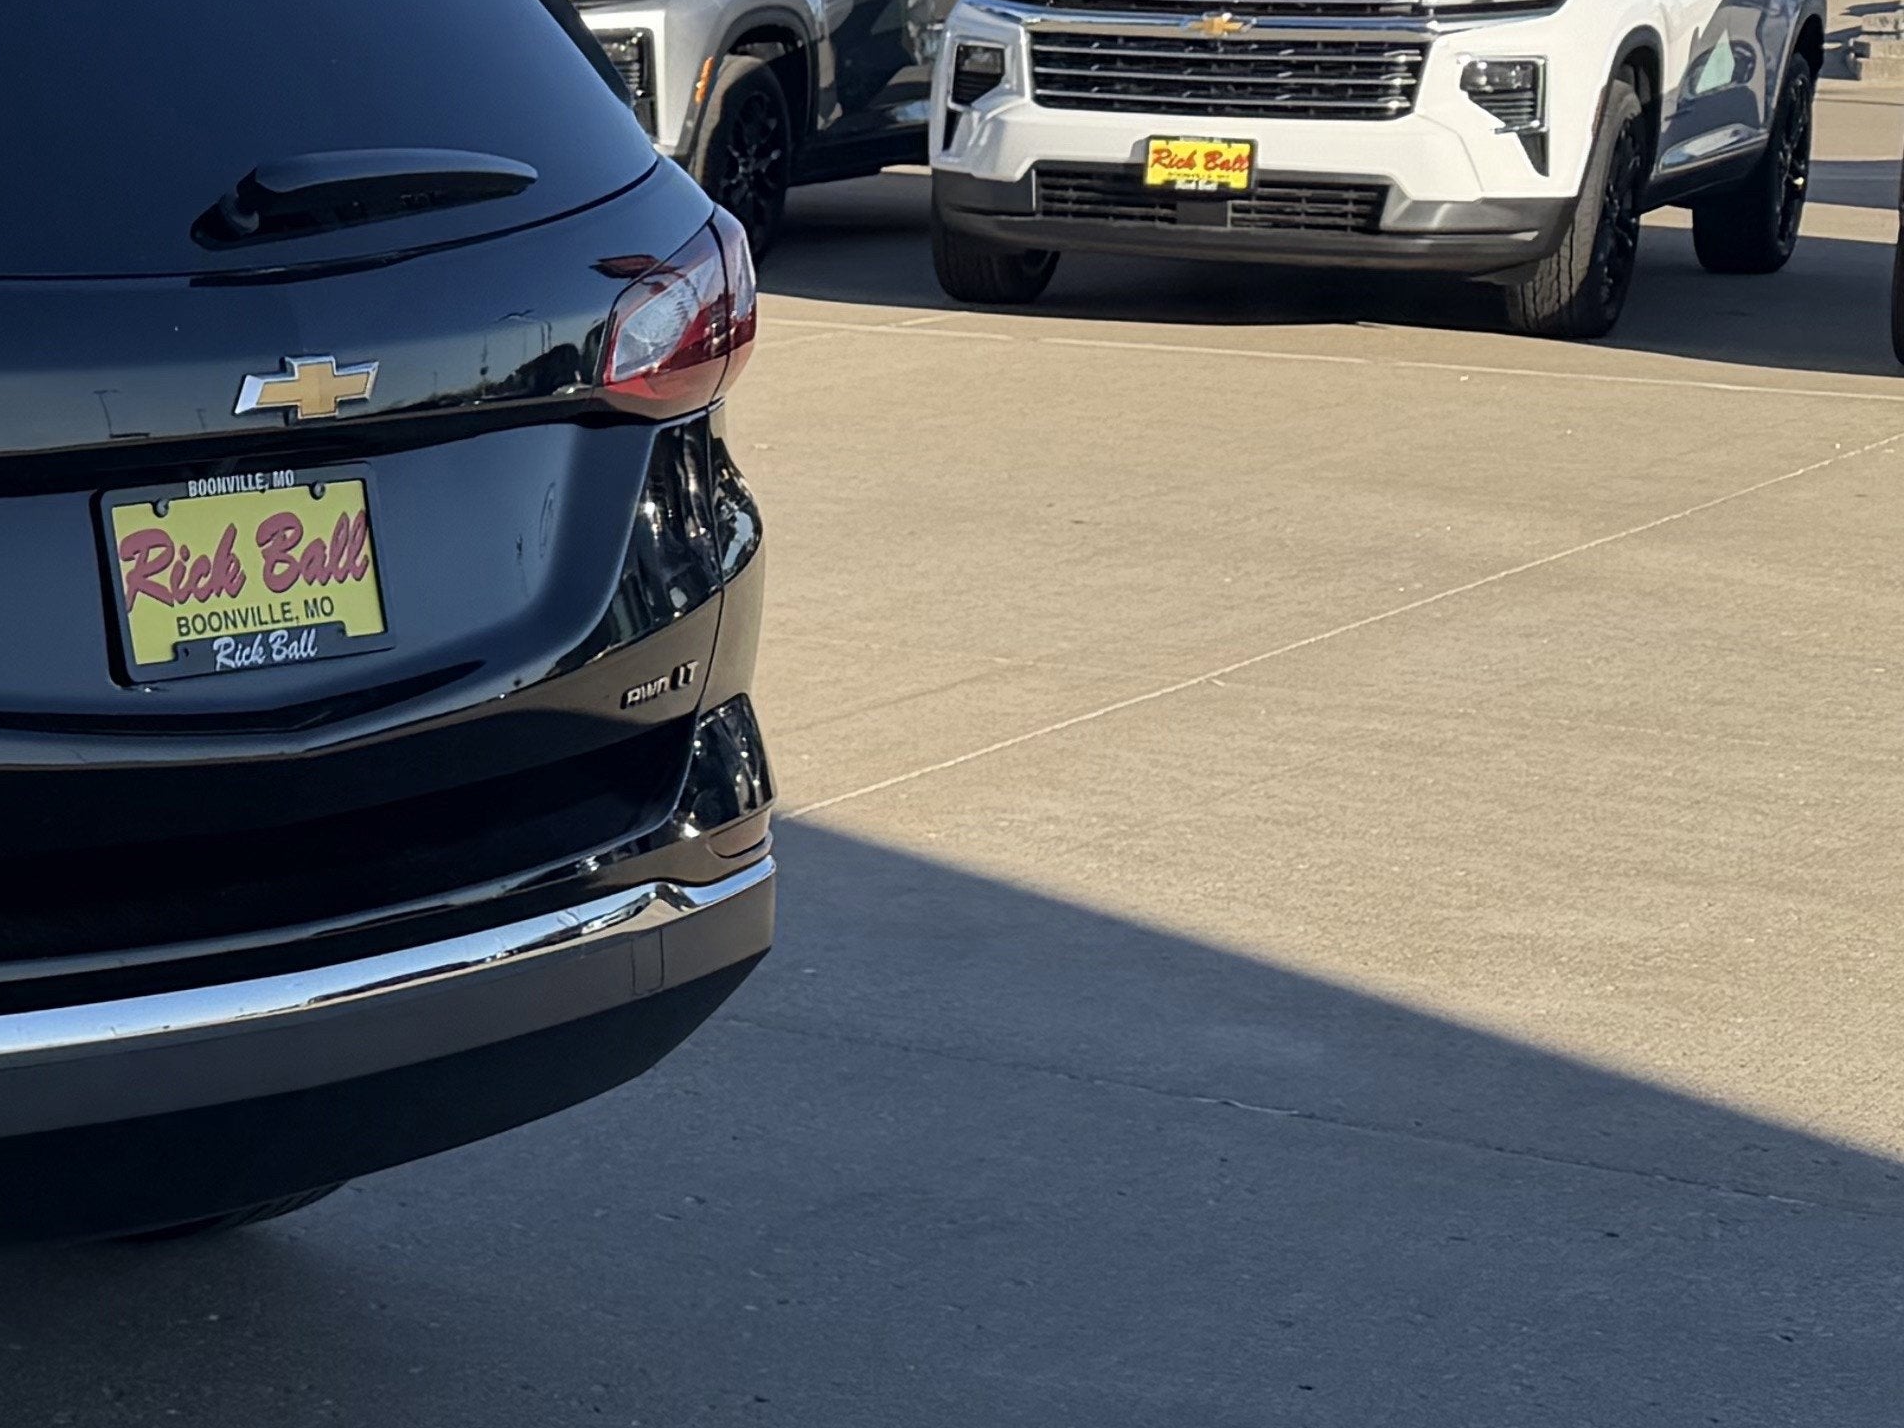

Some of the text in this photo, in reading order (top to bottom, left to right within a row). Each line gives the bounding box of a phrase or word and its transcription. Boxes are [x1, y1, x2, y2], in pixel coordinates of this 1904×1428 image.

[1151, 148, 1250, 172] Rick Ball
[188, 469, 295, 497] BOONVILLE, MO
[119, 509, 370, 613] Rick Ball
[176, 595, 335, 638] BOONVILLE, MO
[212, 628, 319, 672] Rick Ball
[676, 660, 699, 689] LT
